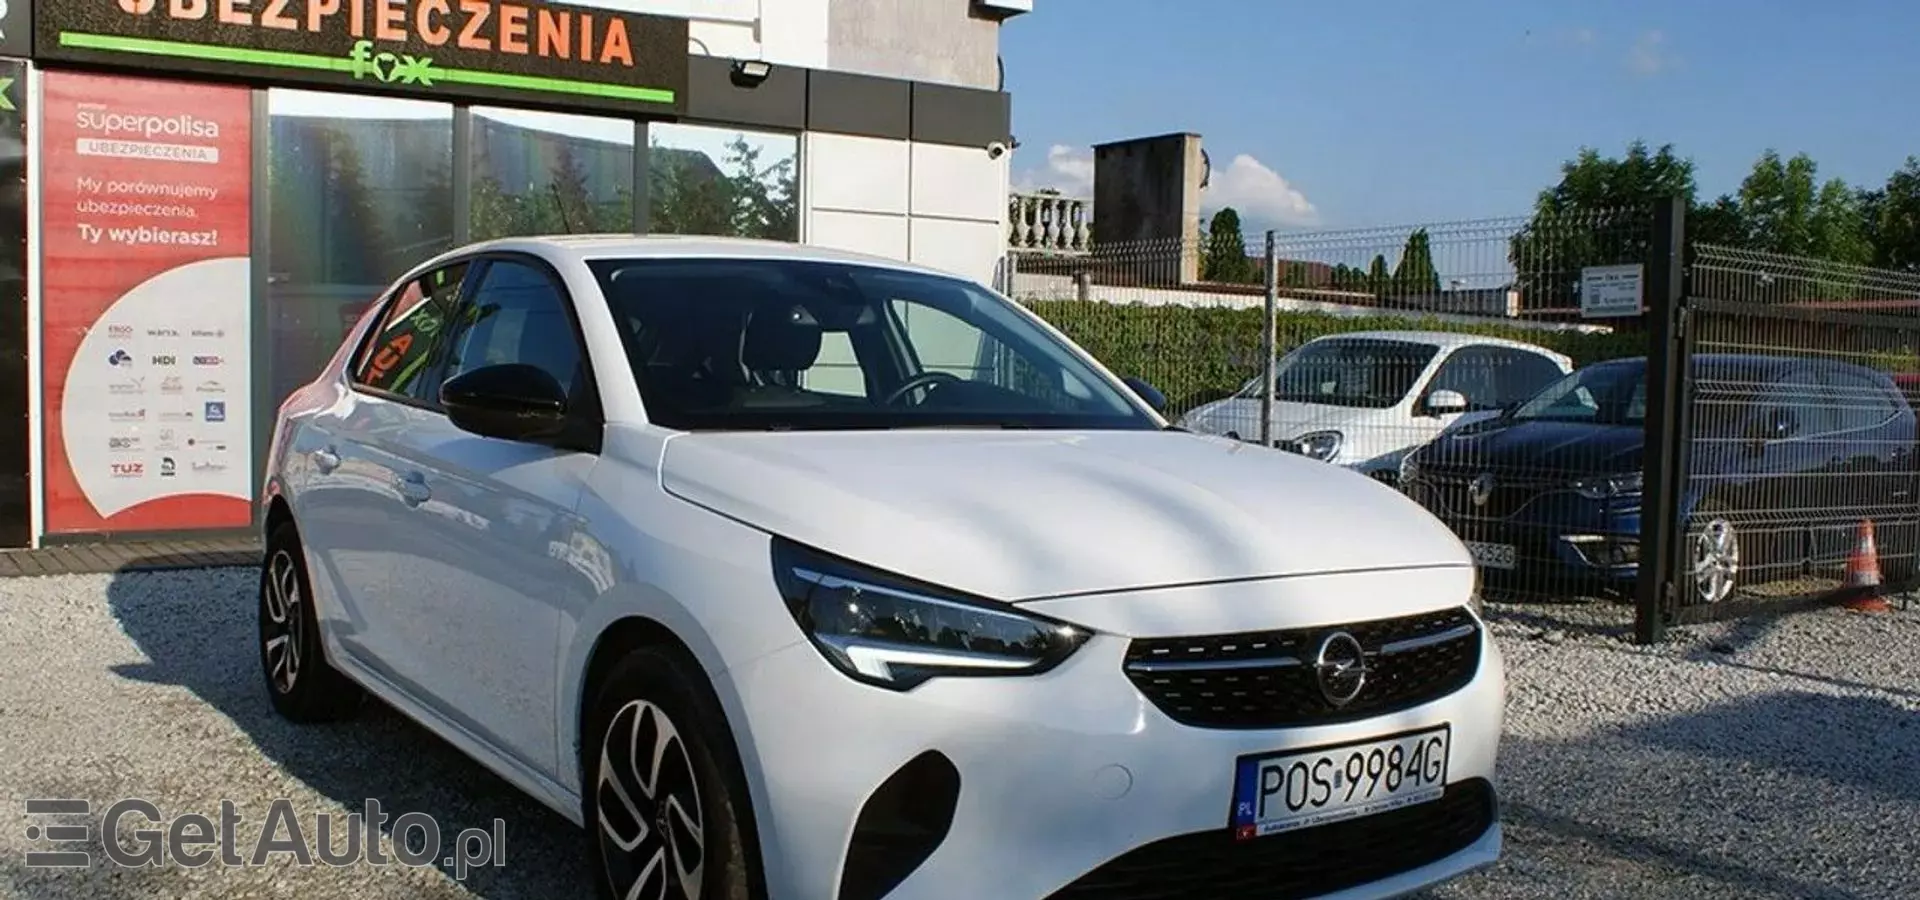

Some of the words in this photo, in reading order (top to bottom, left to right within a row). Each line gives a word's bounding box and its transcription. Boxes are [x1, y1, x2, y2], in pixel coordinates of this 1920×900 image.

[76, 111, 219, 138] superpolisa
[89, 141, 207, 160] UBEZPIECZENIA
[77, 177, 102, 195] My
[107, 180, 217, 200] porównujemy
[77, 199, 197, 218] ubezpieczenia.
[77, 223, 103, 244] Ty
[108, 226, 217, 246] wybierasz!
[152, 356, 176, 365] HDI
[112, 464, 143, 473] TUZ
[1258, 757, 1333, 818] POS
[1345, 736, 1443, 803] 9984G
